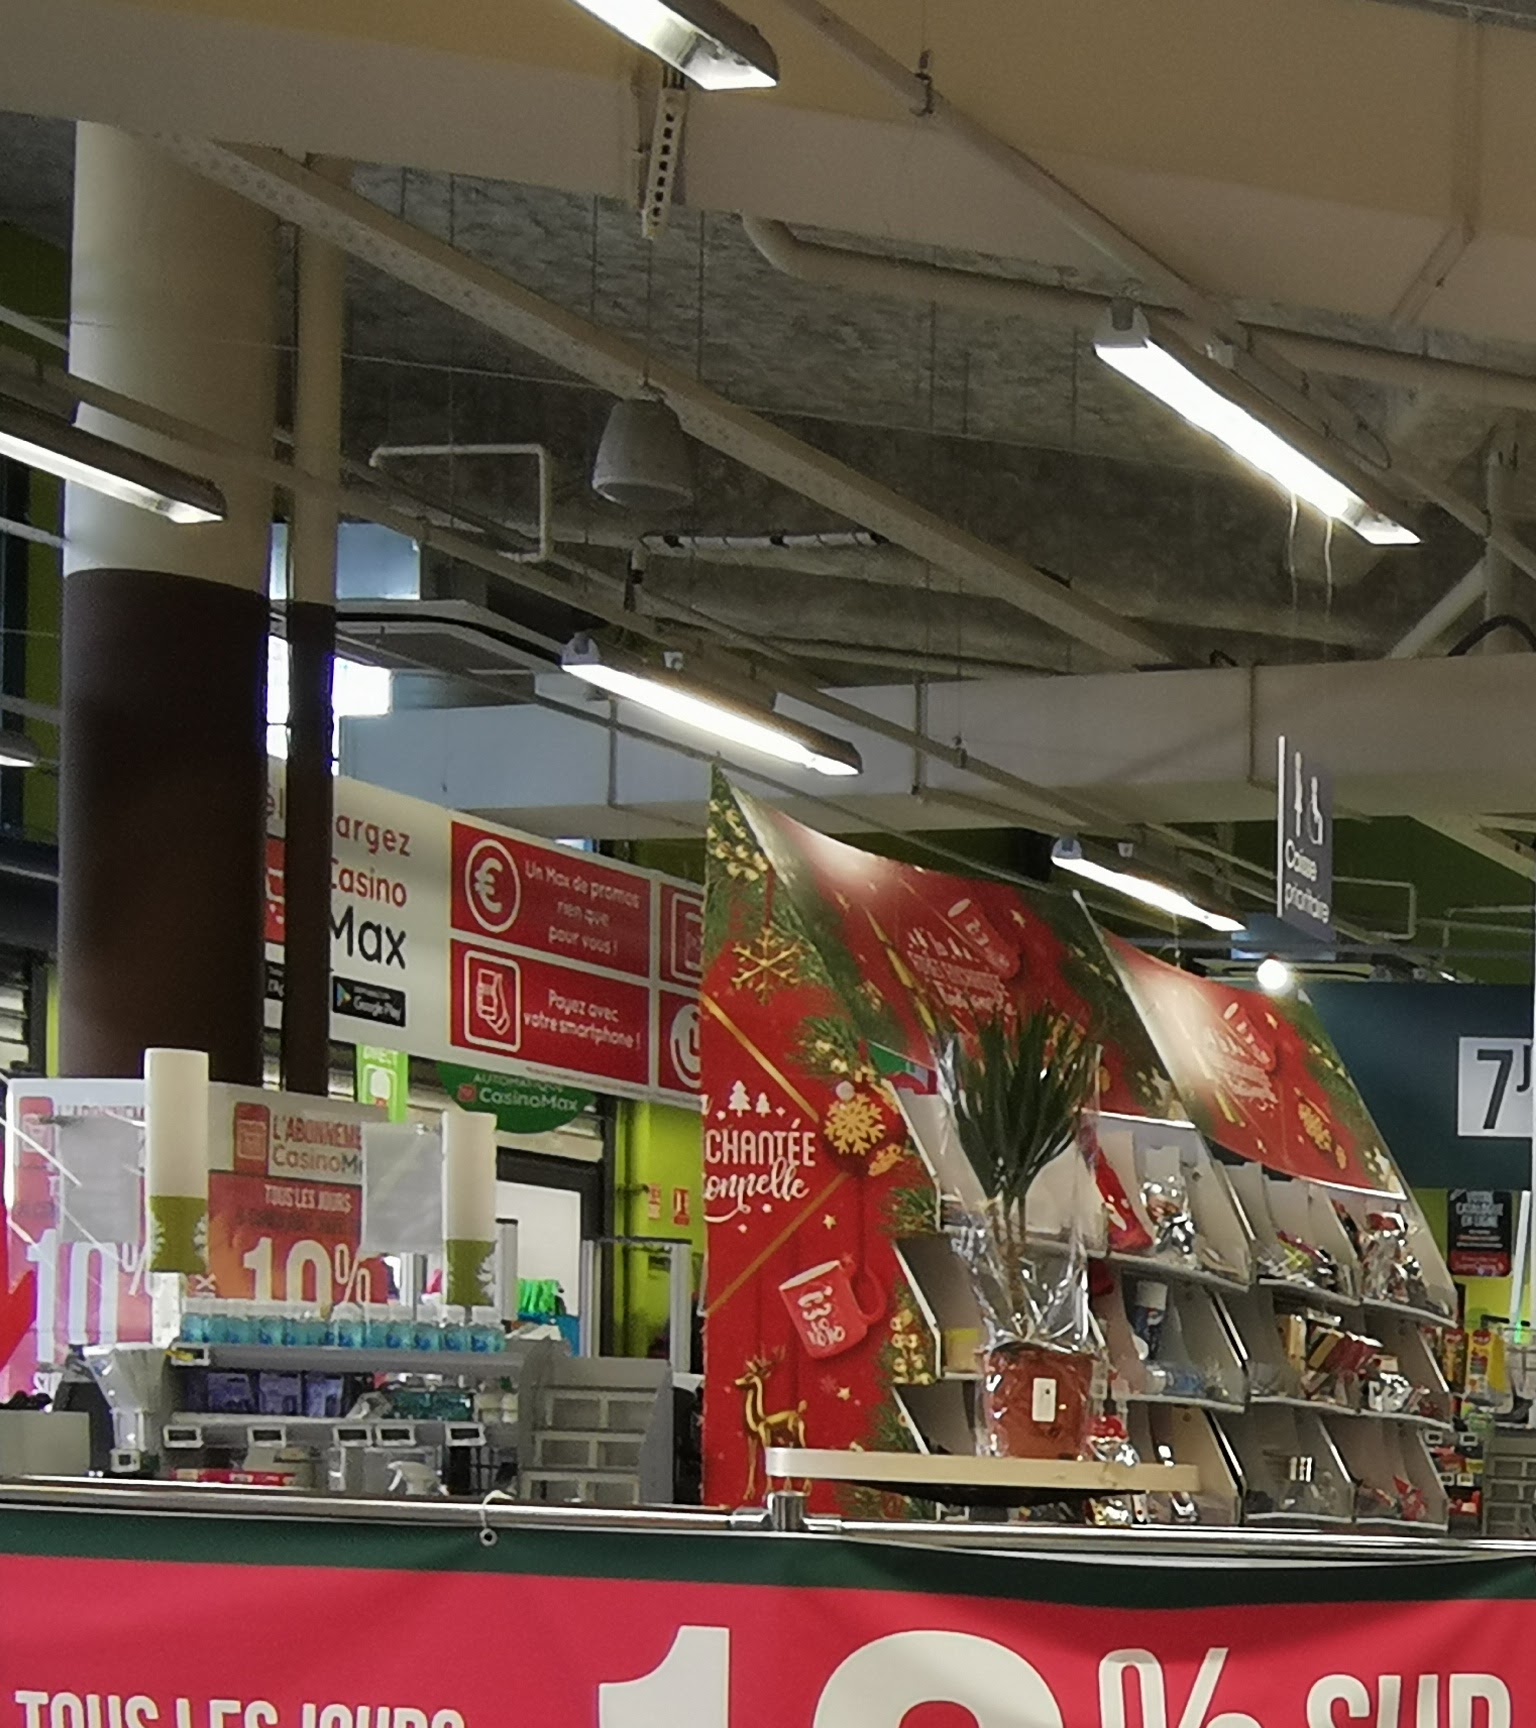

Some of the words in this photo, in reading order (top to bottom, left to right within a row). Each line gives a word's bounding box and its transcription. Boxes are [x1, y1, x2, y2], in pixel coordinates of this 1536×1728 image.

[330, 904, 407, 970] Max
[548, 988, 586, 1016] Payez
[523, 1010, 557, 1032] votre
[560, 1020, 634, 1048] smartphone
[479, 1087, 579, 1112] CasinoMax
[273, 1145, 362, 1176] CasinoM
